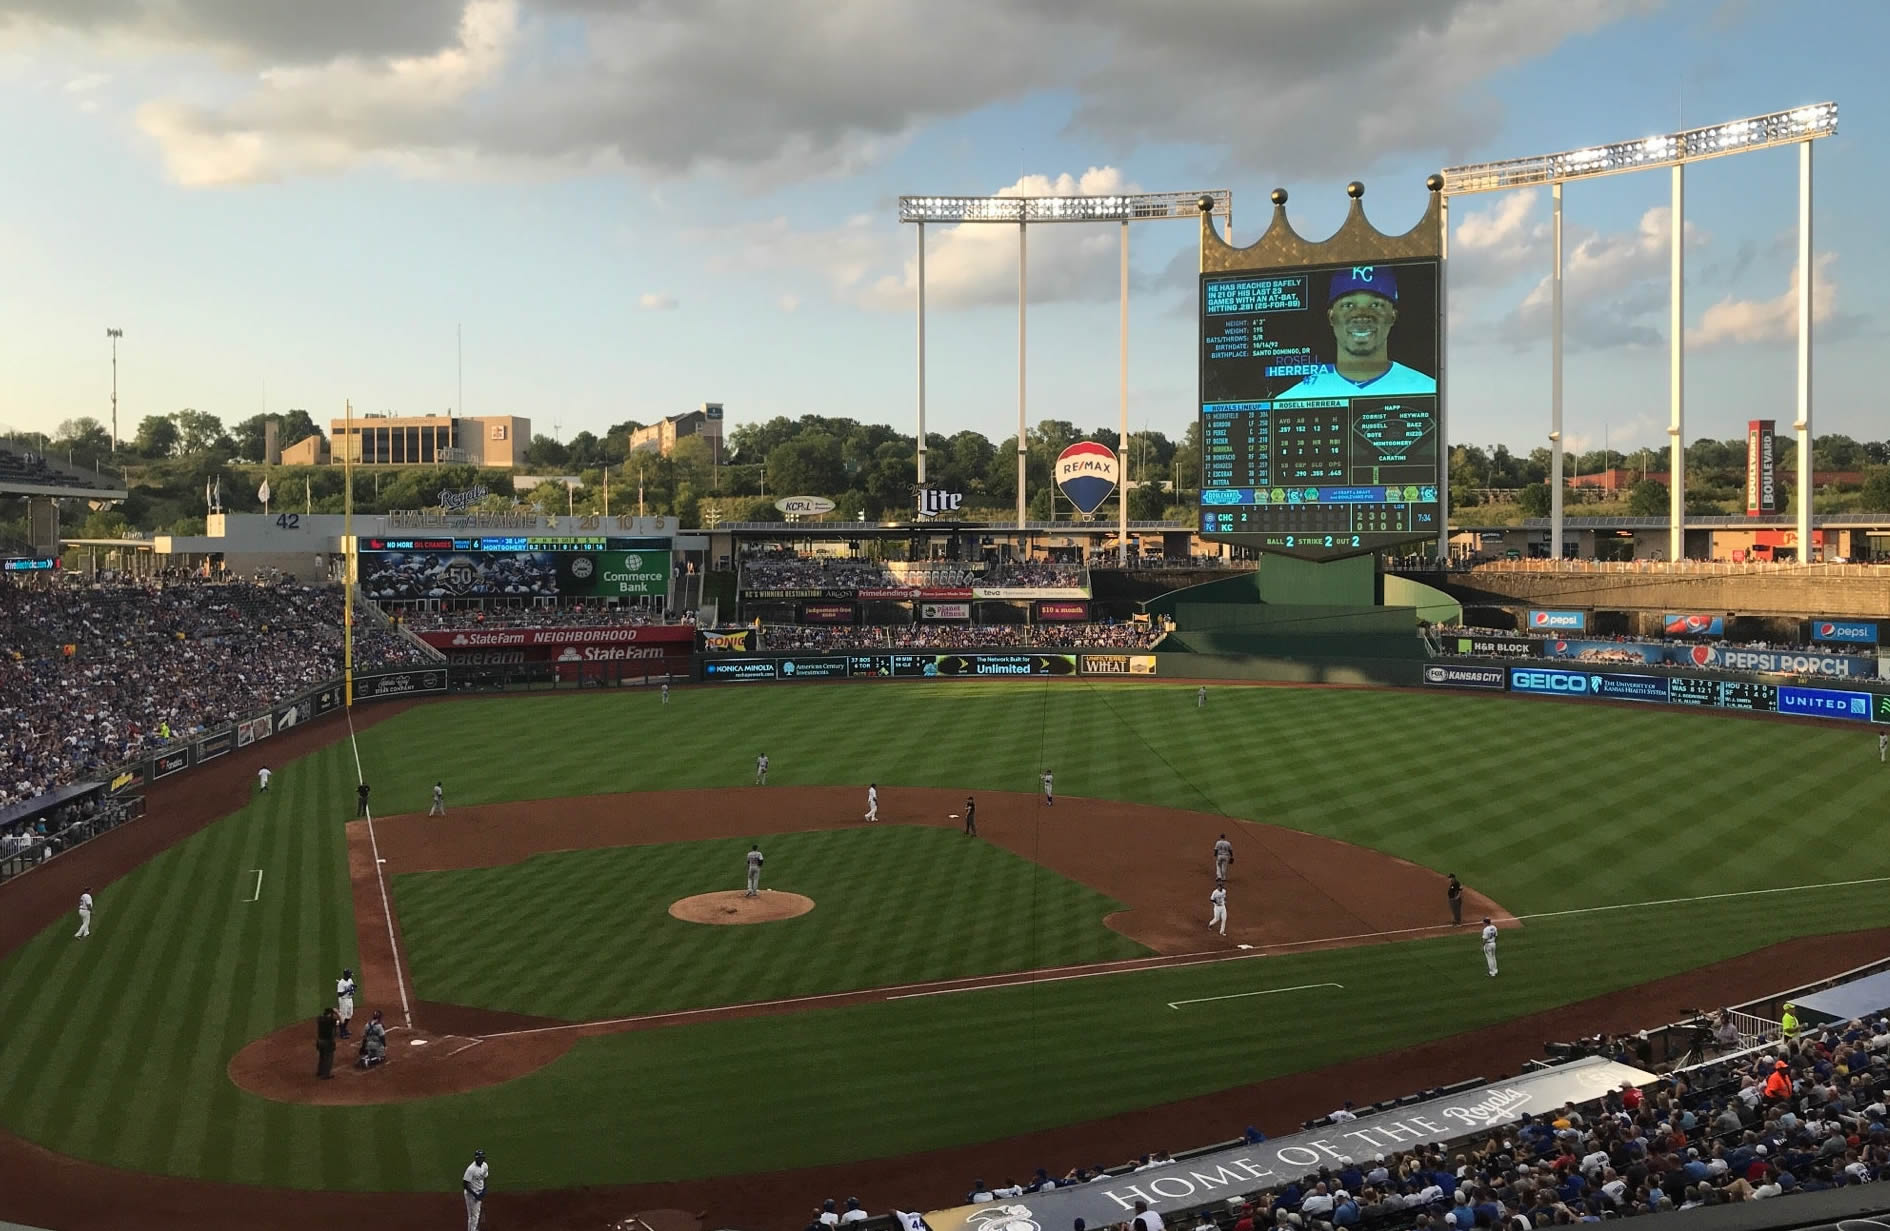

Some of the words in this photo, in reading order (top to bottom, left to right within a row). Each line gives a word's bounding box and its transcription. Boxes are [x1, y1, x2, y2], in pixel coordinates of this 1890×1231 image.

[1352, 266, 1373, 282] KC
[1208, 284, 1218, 292] HE
[1220, 283, 1235, 291] HAS
[1236, 282, 1271, 290] REACHED
[1272, 279, 1301, 288] SAFELY
[1252, 288, 1270, 296] LAST
[1208, 298, 1234, 306] GAMES
[1208, 304, 1238, 313] HITTING
[1206, 336, 1248, 344] BATS/THROWS:
[1272, 348, 1301, 356] DOMINGO,
[1276, 354, 1321, 366] ROSELL
[1269, 364, 1329, 376] HERRERA
[1064, 461, 1110, 474] RE/MAX
[1763, 436, 1774, 504] BOULEVARD
[438, 484, 488, 511] Royals
[920, 488, 962, 516] Lite
[786, 502, 811, 511] KCP&L
[277, 514, 299, 528] 42
[388, 510, 448, 528] HALL
[476, 510, 537, 528] FAME
[1357, 512, 1363, 520] 2
[1369, 512, 1375, 520] 3
[580, 516, 600, 530] 20
[618, 515, 633, 530] 10
[656, 515, 664, 530] 5
[1286, 536, 1294, 547] 2
[1325, 536, 1332, 547] 2
[1352, 536, 1360, 547] 2
[450, 568, 472, 584] 50
[604, 571, 663, 582] Commerce
[620, 582, 648, 592] Bank
[825, 590, 853, 598] ARGOSY
[859, 590, 908, 598] PrimeLending
[1550, 616, 1577, 625] pepsi
[534, 630, 636, 643] NEIGHBORHOOD
[1837, 626, 1868, 637] pepsi
[707, 637, 744, 647] SONIC
[1474, 642, 1495, 651] H&R
[1497, 643, 1529, 652] BLOCK
[977, 664, 1030, 674] Unlimited
[1086, 660, 1125, 673] WHEAT
[1726, 652, 1775, 670] PEPSI
[1781, 655, 1849, 675] PORCH
[1448, 671, 1482, 681] KANSAS
[1482, 673, 1502, 682] CITY
[1513, 672, 1587, 691] GEICO
[1785, 696, 1847, 710] UNITED
[1101, 1158, 1272, 1210] HOME
[1278, 1139, 1344, 1166] OF
[1343, 1116, 1450, 1148] THE
[1443, 1087, 1532, 1126] Royals
[912, 1220, 925, 1230] 44
